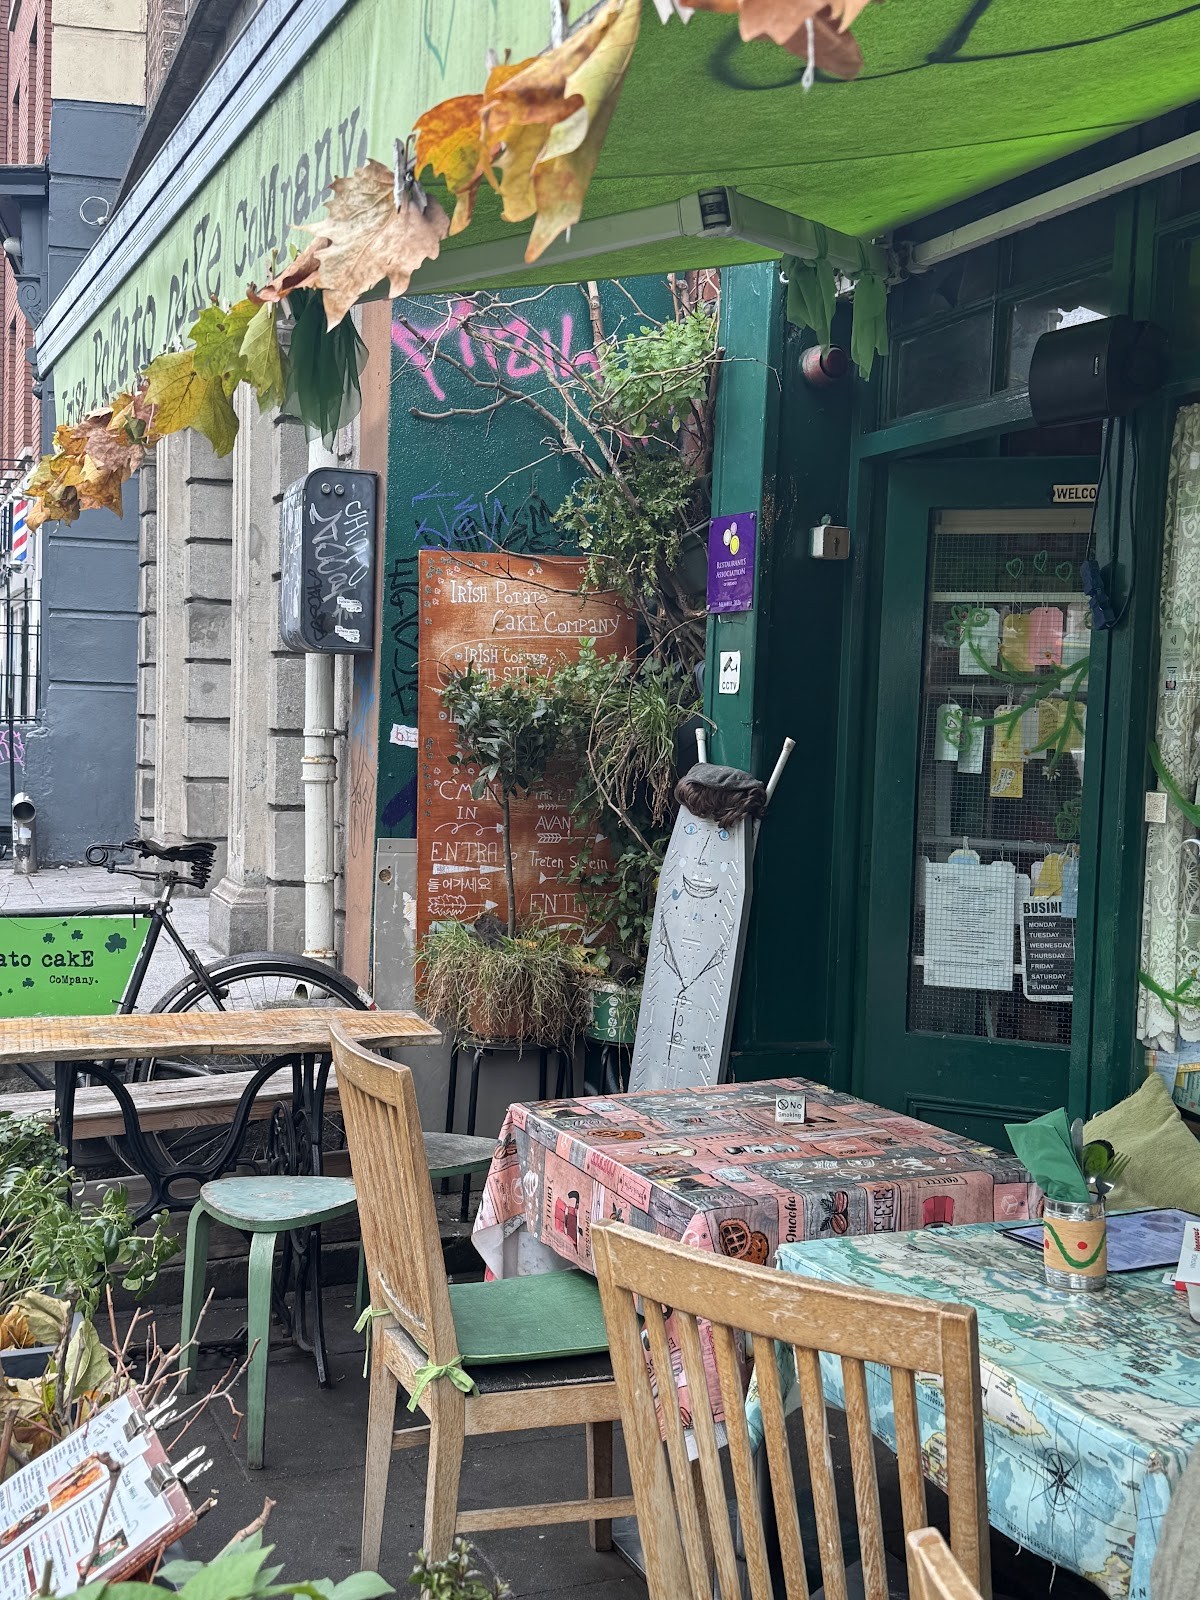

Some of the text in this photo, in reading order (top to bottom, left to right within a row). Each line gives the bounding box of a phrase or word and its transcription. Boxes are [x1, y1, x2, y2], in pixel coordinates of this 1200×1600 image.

[1056, 488, 1097, 500] WELCO
[716, 558, 747, 569] RESTAURANTS
[716, 568, 746, 578] ASSOCIATION
[721, 681, 738, 690] CCTV
[456, 806, 478, 820] IN
[528, 850, 564, 869] Treten
[589, 859, 609, 870] ein
[427, 877, 491, 894] 들어가세요
[1023, 901, 1062, 915] BUSIN
[790, 1101, 803, 1110] No
[777, 1111, 802, 1120] Smoking
